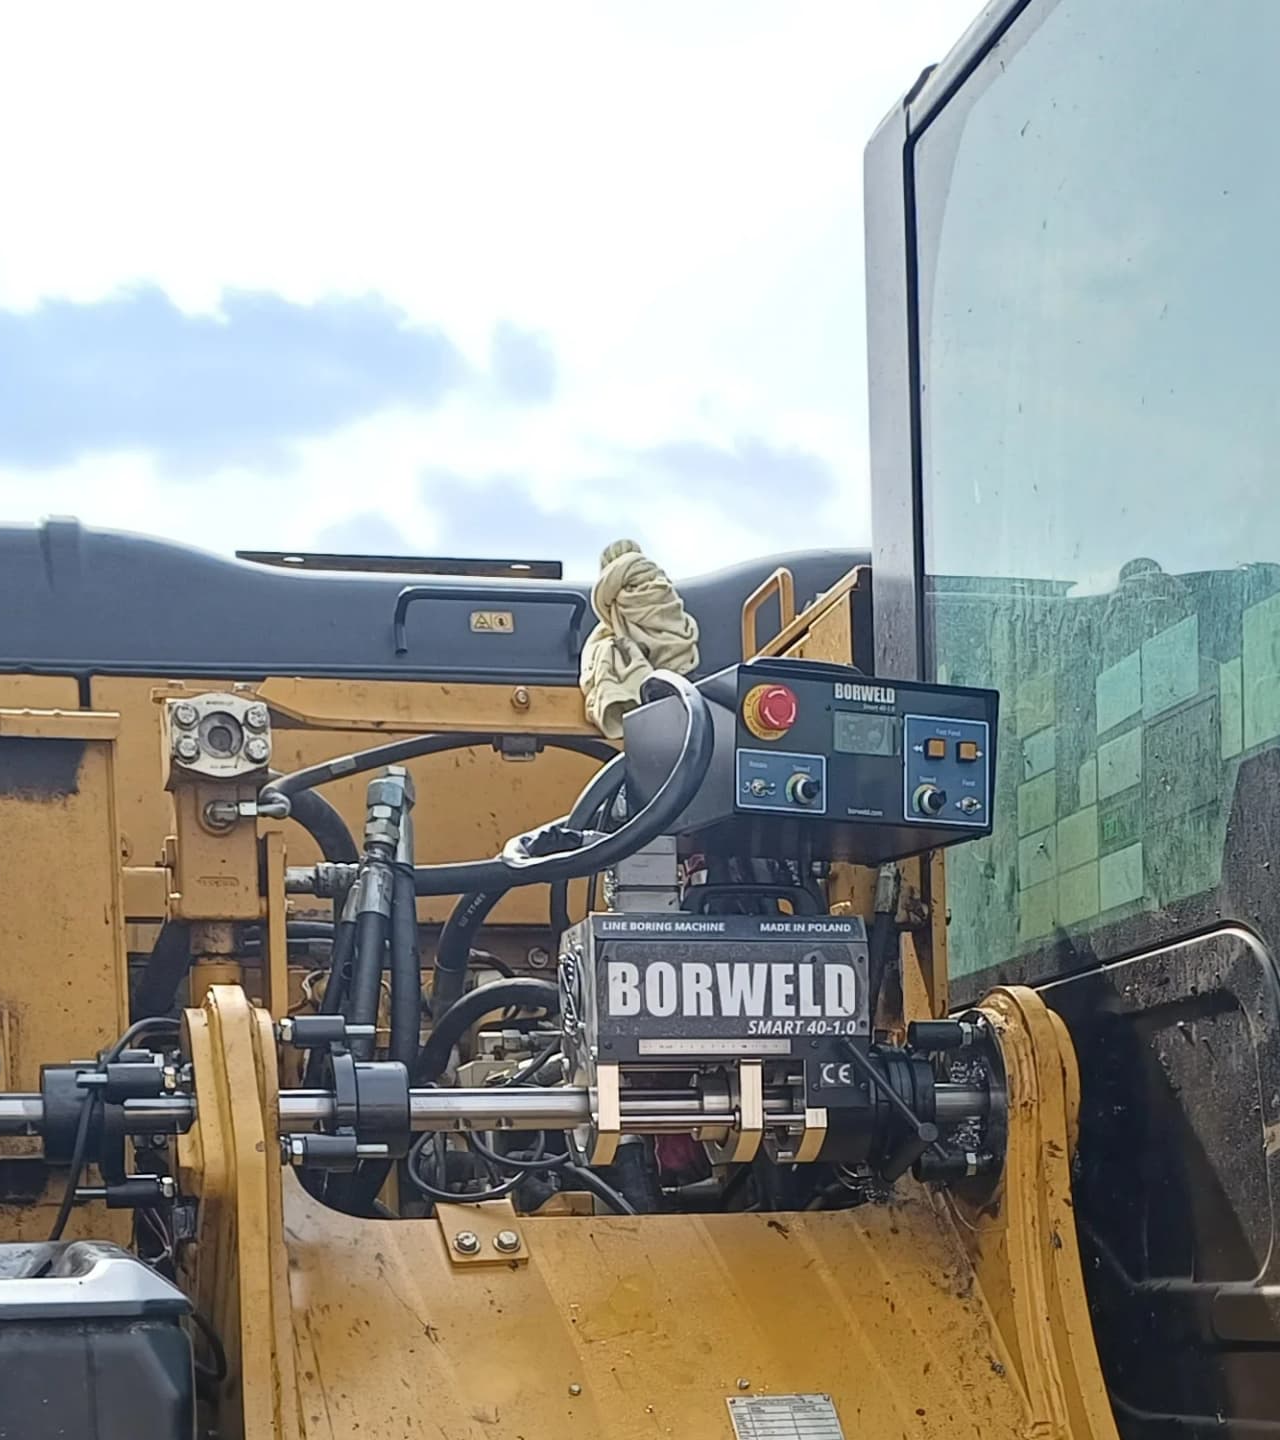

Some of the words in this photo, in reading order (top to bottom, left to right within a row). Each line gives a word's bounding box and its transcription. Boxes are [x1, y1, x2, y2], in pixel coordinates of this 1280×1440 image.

[834, 682, 896, 704] BORWELD
[602, 921, 628, 931] LINE
[629, 921, 672, 932] BORING
[673, 922, 726, 932] MACHINE
[759, 923, 791, 933] MADE
[793, 924, 806, 933] IN
[807, 923, 852, 933] POLAND
[607, 961, 856, 1017] BORWELD
[748, 1020, 805, 1035] SMART
[806, 1020, 856, 1035] 40-1.0
